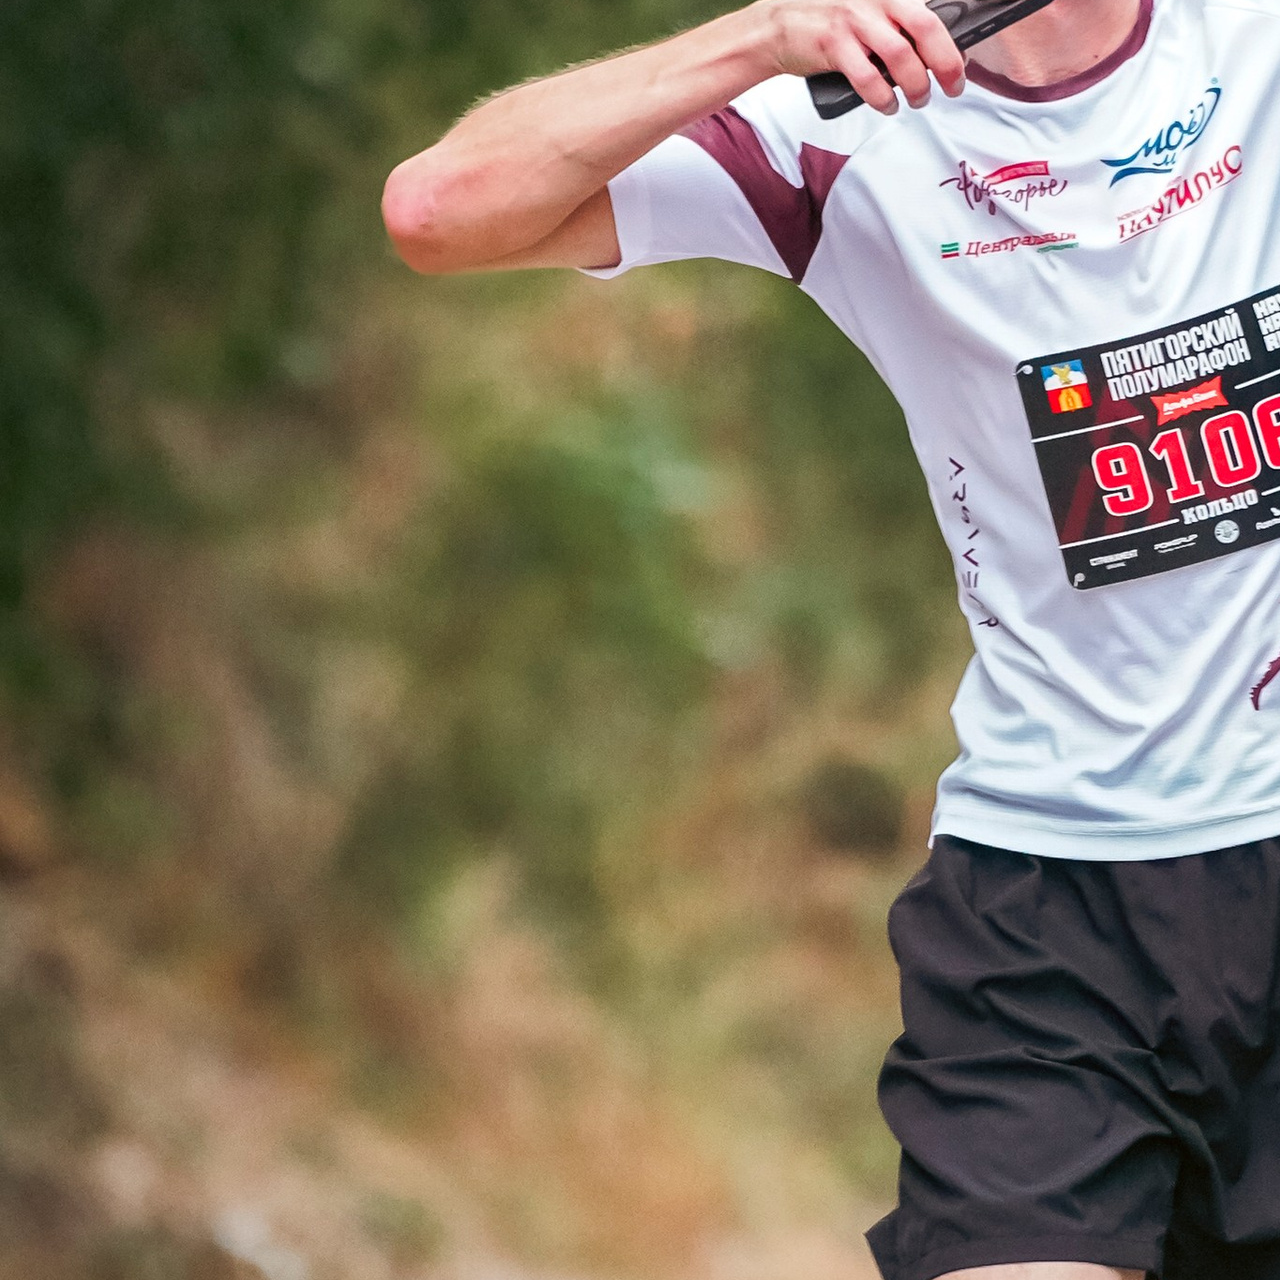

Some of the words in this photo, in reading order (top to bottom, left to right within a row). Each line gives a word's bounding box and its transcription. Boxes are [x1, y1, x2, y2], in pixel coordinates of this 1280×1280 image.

[1100, 307, 1245, 378] ПЯТИГОРСКИЙ
[1108, 337, 1251, 402] ПОЛУМАРАФОН
[1181, 489, 1258, 525] КОЛЬЦО
